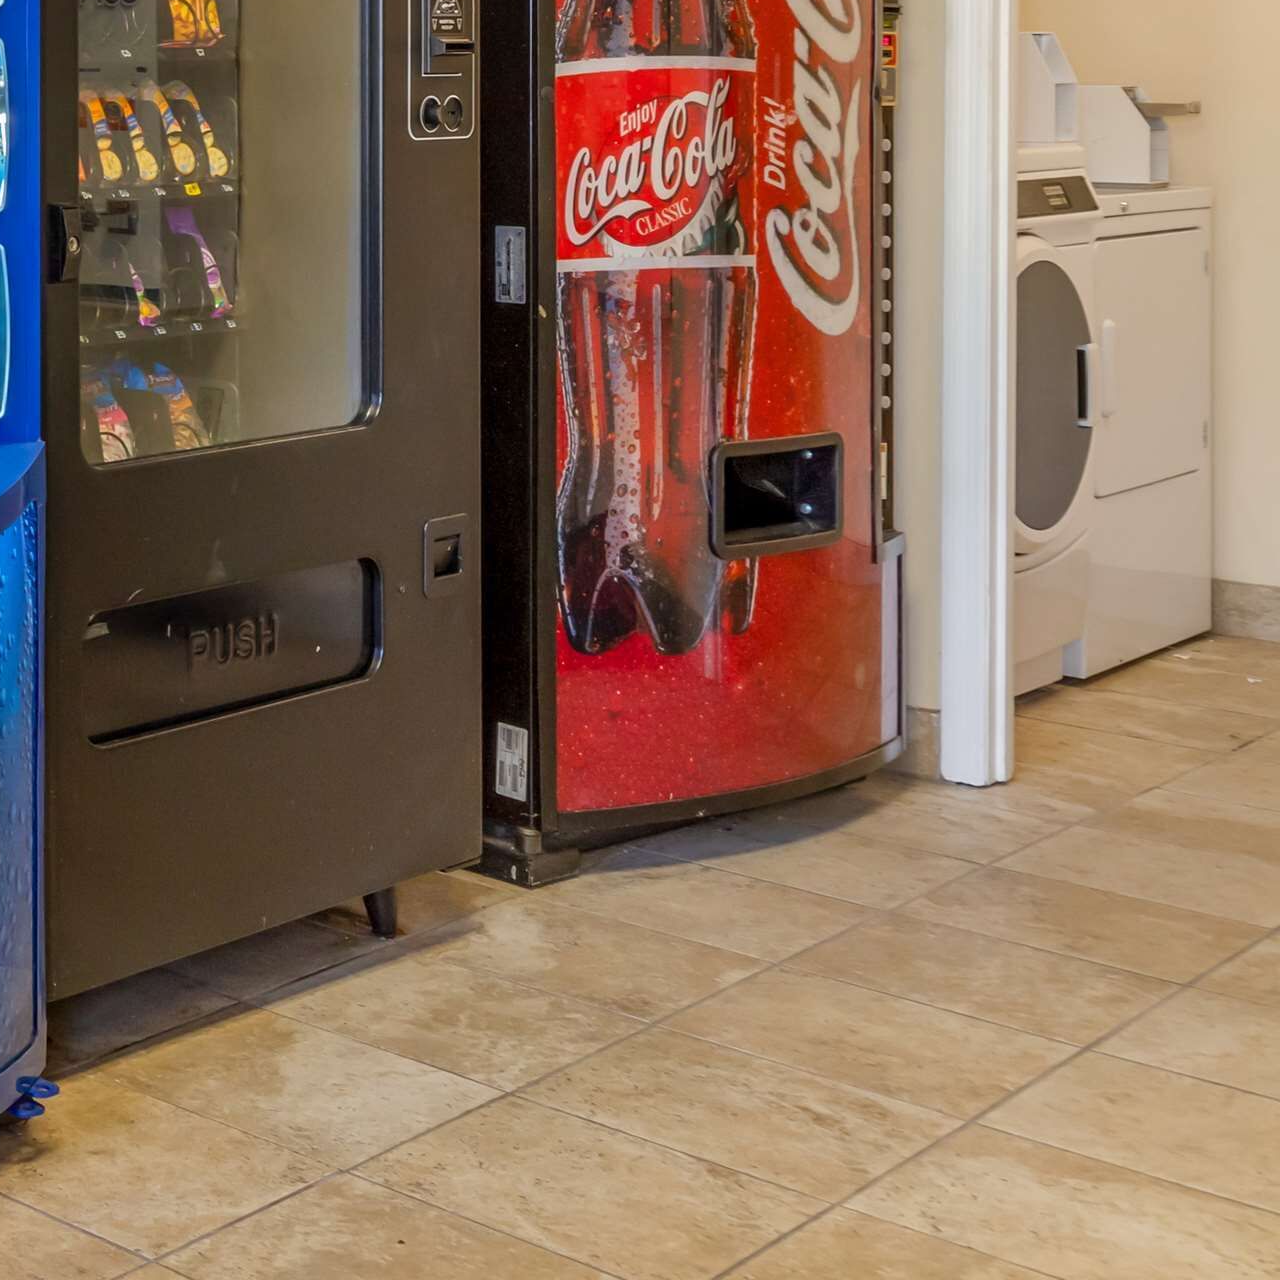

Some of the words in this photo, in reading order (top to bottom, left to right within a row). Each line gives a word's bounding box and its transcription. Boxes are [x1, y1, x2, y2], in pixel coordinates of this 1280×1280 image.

[619, 99, 658, 137] Enjoy
[763, 96, 788, 191] Drink!
[565, 75, 737, 246] Coca-Cola
[635, 197, 692, 236] CLASSIC
[188, 608, 280, 671] PUSH
